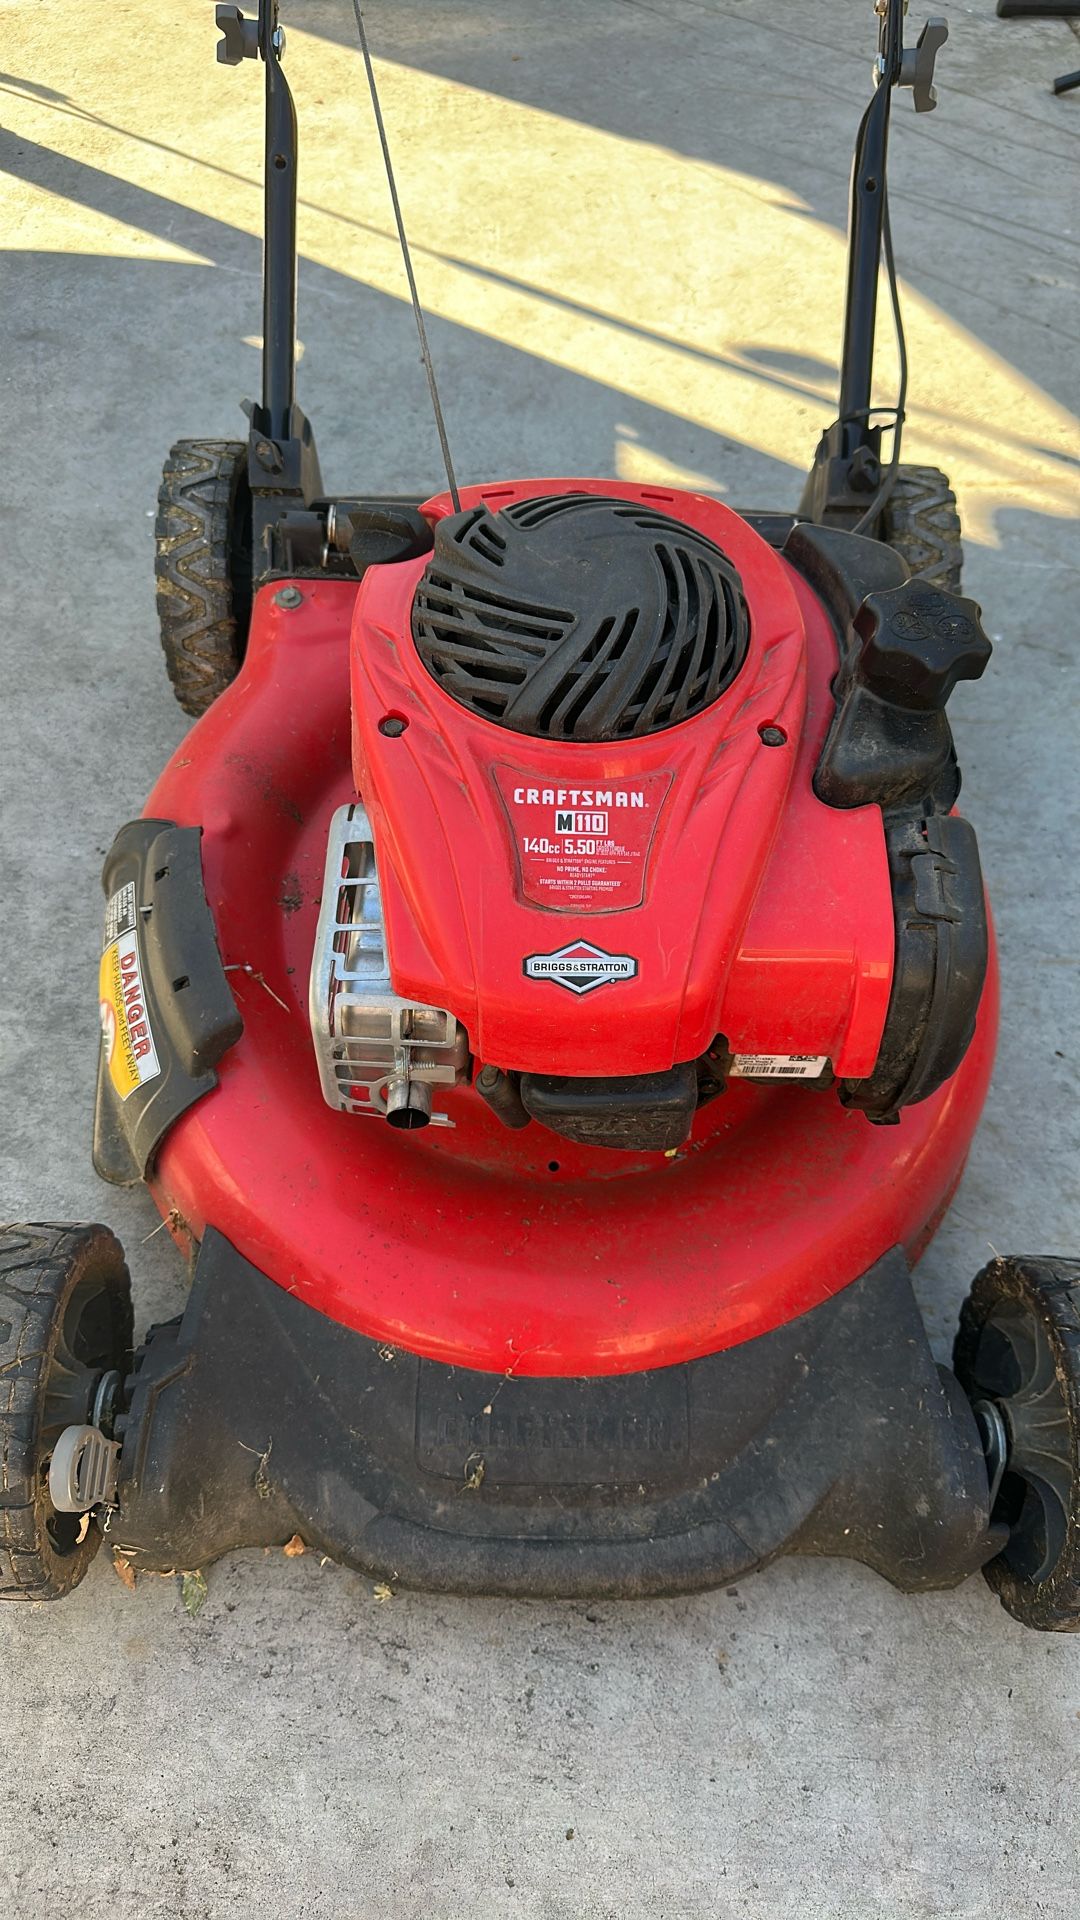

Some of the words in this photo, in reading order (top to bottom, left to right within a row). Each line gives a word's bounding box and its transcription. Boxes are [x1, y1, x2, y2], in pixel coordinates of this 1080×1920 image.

[523, 837, 561, 854] 140cc
[564, 839, 596, 855] 5.50
[111, 948, 119, 973] KEEP
[113, 975, 124, 1008] HANDS
[117, 1008, 126, 1026] and
[120, 951, 151, 1061] DANGER
[120, 1025, 133, 1052] FEET
[125, 1053, 140, 1082] AWAY
